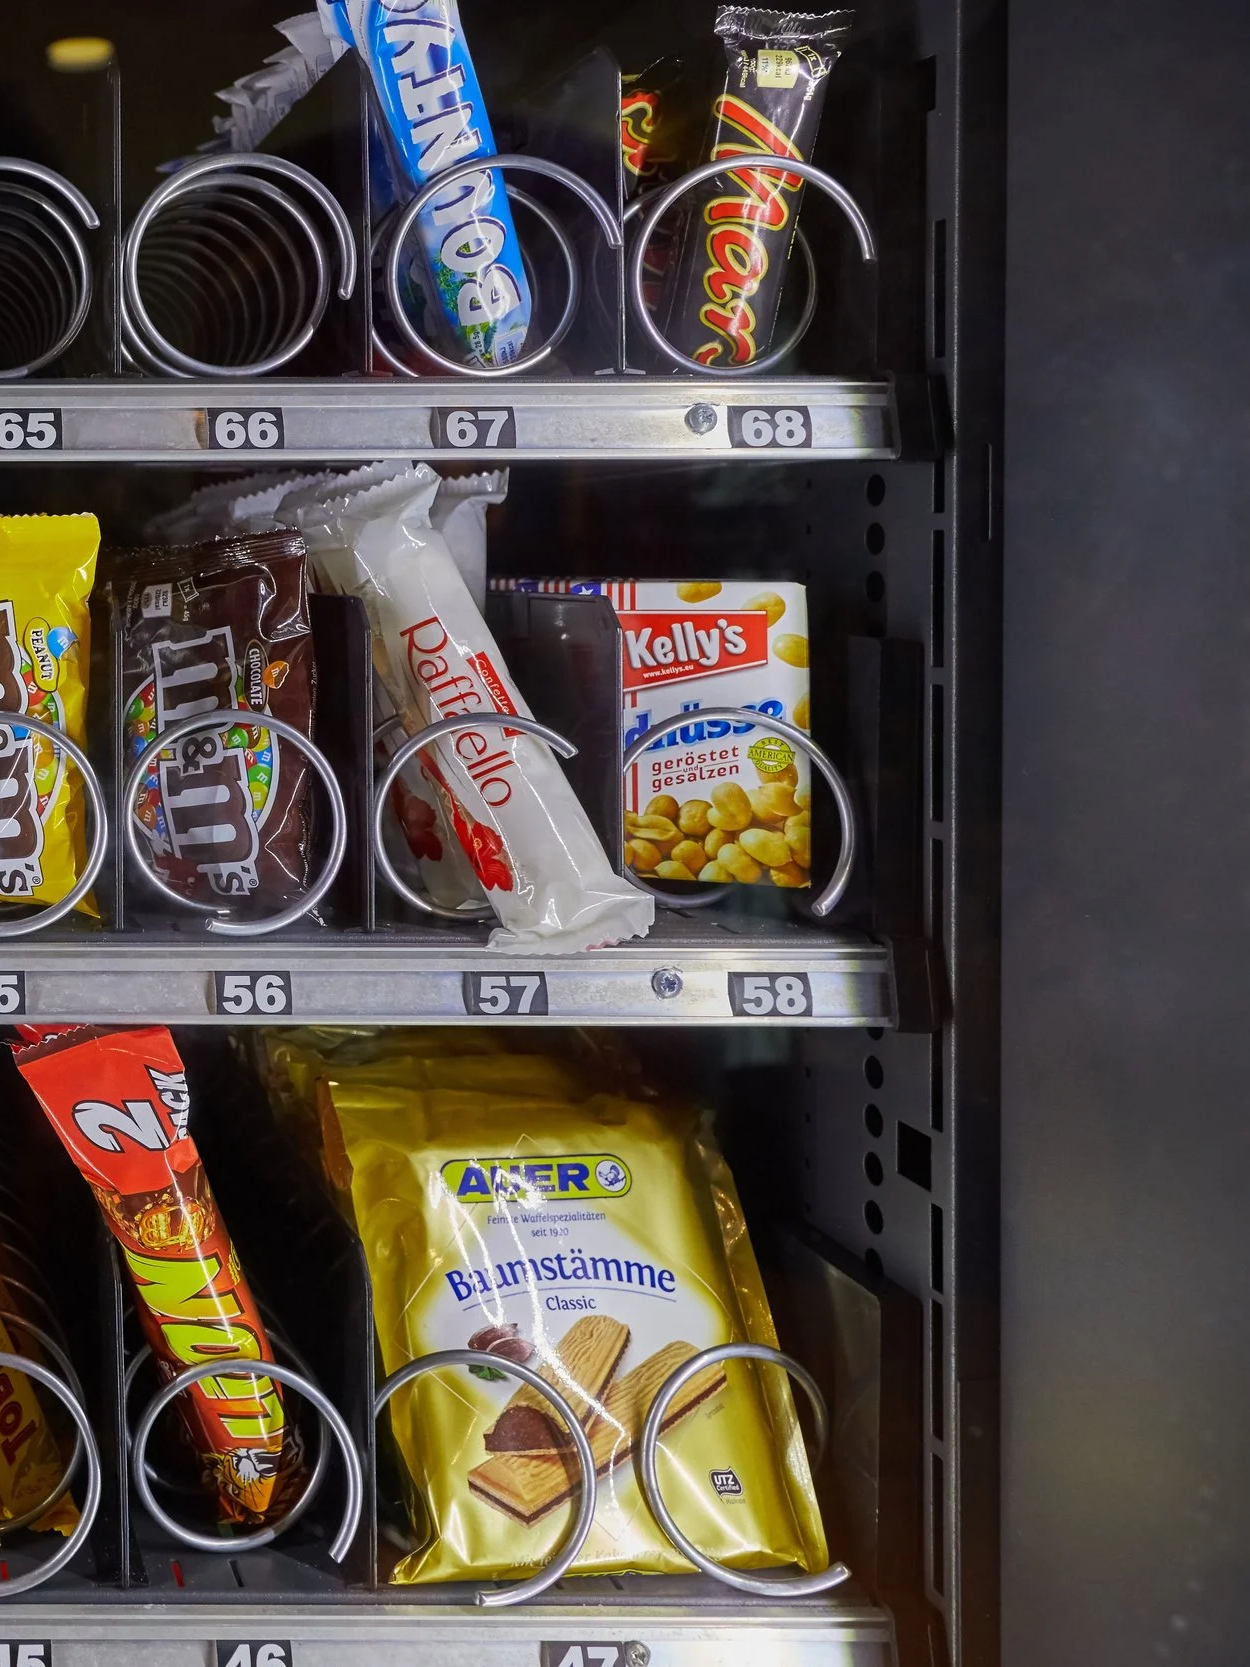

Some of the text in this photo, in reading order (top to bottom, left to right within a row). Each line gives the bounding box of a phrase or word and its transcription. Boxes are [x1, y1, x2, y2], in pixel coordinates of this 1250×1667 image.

[383, 19, 521, 327] BOUNTY
[213, 414, 279, 449] 66
[444, 413, 511, 449] 67
[740, 412, 806, 448] 68
[32, 628, 53, 681] PEANUT
[624, 618, 747, 670] Kelly's
[248, 649, 263, 706] CHOCOLATE
[642, 665, 694, 680] www.kellys.eu
[749, 751, 794, 762] AMERICAN
[761, 738, 784, 747] BEST
[652, 746, 739, 775] geröstet
[683, 765, 699, 773] und
[756, 761, 783, 772] QUALITY
[652, 764, 739, 793] gesalzen
[221, 975, 288, 1014] 56
[477, 974, 541, 1014] 57
[741, 974, 805, 1014] 58
[72, 1099, 172, 1152] 2
[456, 1162, 591, 1197] AUER
[520, 1211, 606, 1224] Waffelspezialitäten
[531, 1228, 547, 1238] seit
[445, 1248, 676, 1302] Baumstämme
[545, 1295, 597, 1312] Classic
[124, 1243, 285, 1439] LION
[714, 1473, 734, 1485] UTZ
[716, 1483, 740, 1492] Certified
